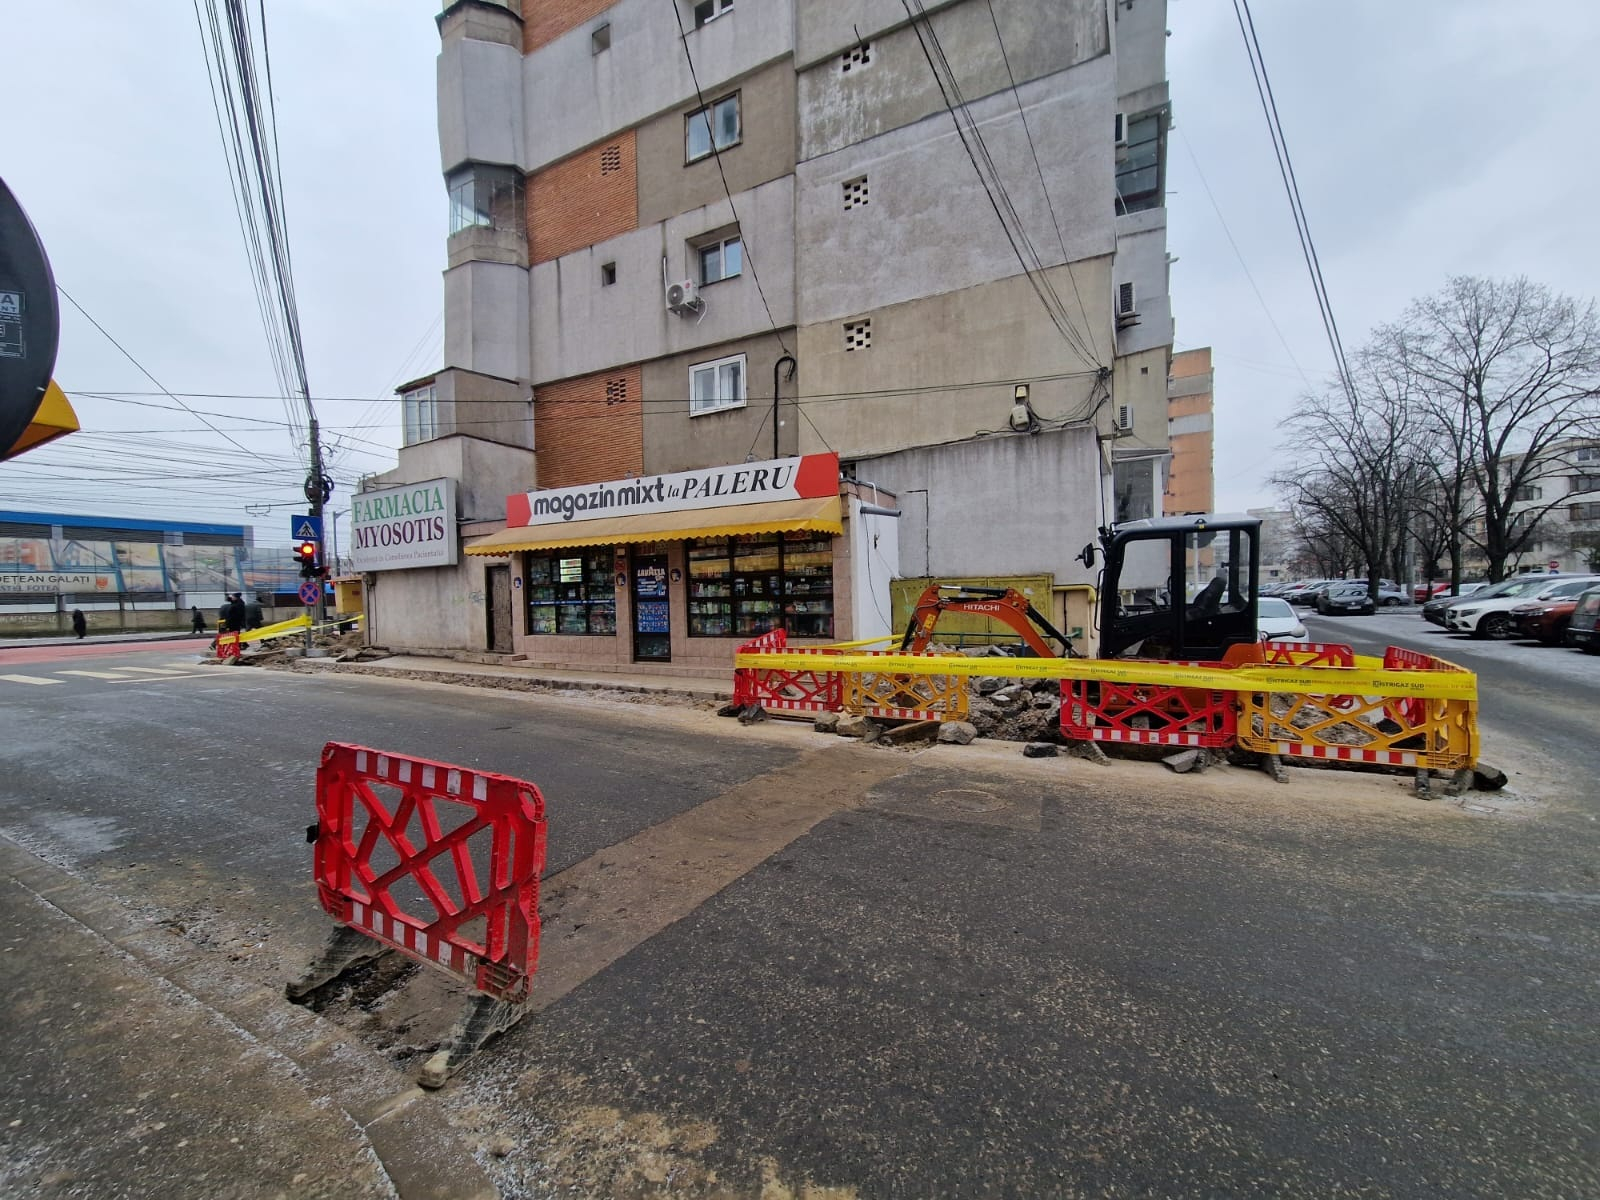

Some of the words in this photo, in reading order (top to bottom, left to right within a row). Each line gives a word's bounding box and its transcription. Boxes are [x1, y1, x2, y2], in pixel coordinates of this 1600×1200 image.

[353, 486, 444, 522] FARMACIA
[533, 484, 615, 521] magazin
[617, 477, 665, 507] mixt
[667, 484, 680, 498] la
[681, 465, 793, 499] PALERU
[355, 516, 445, 549] MYOSOTIS
[963, 603, 1000, 612] HITACHI
